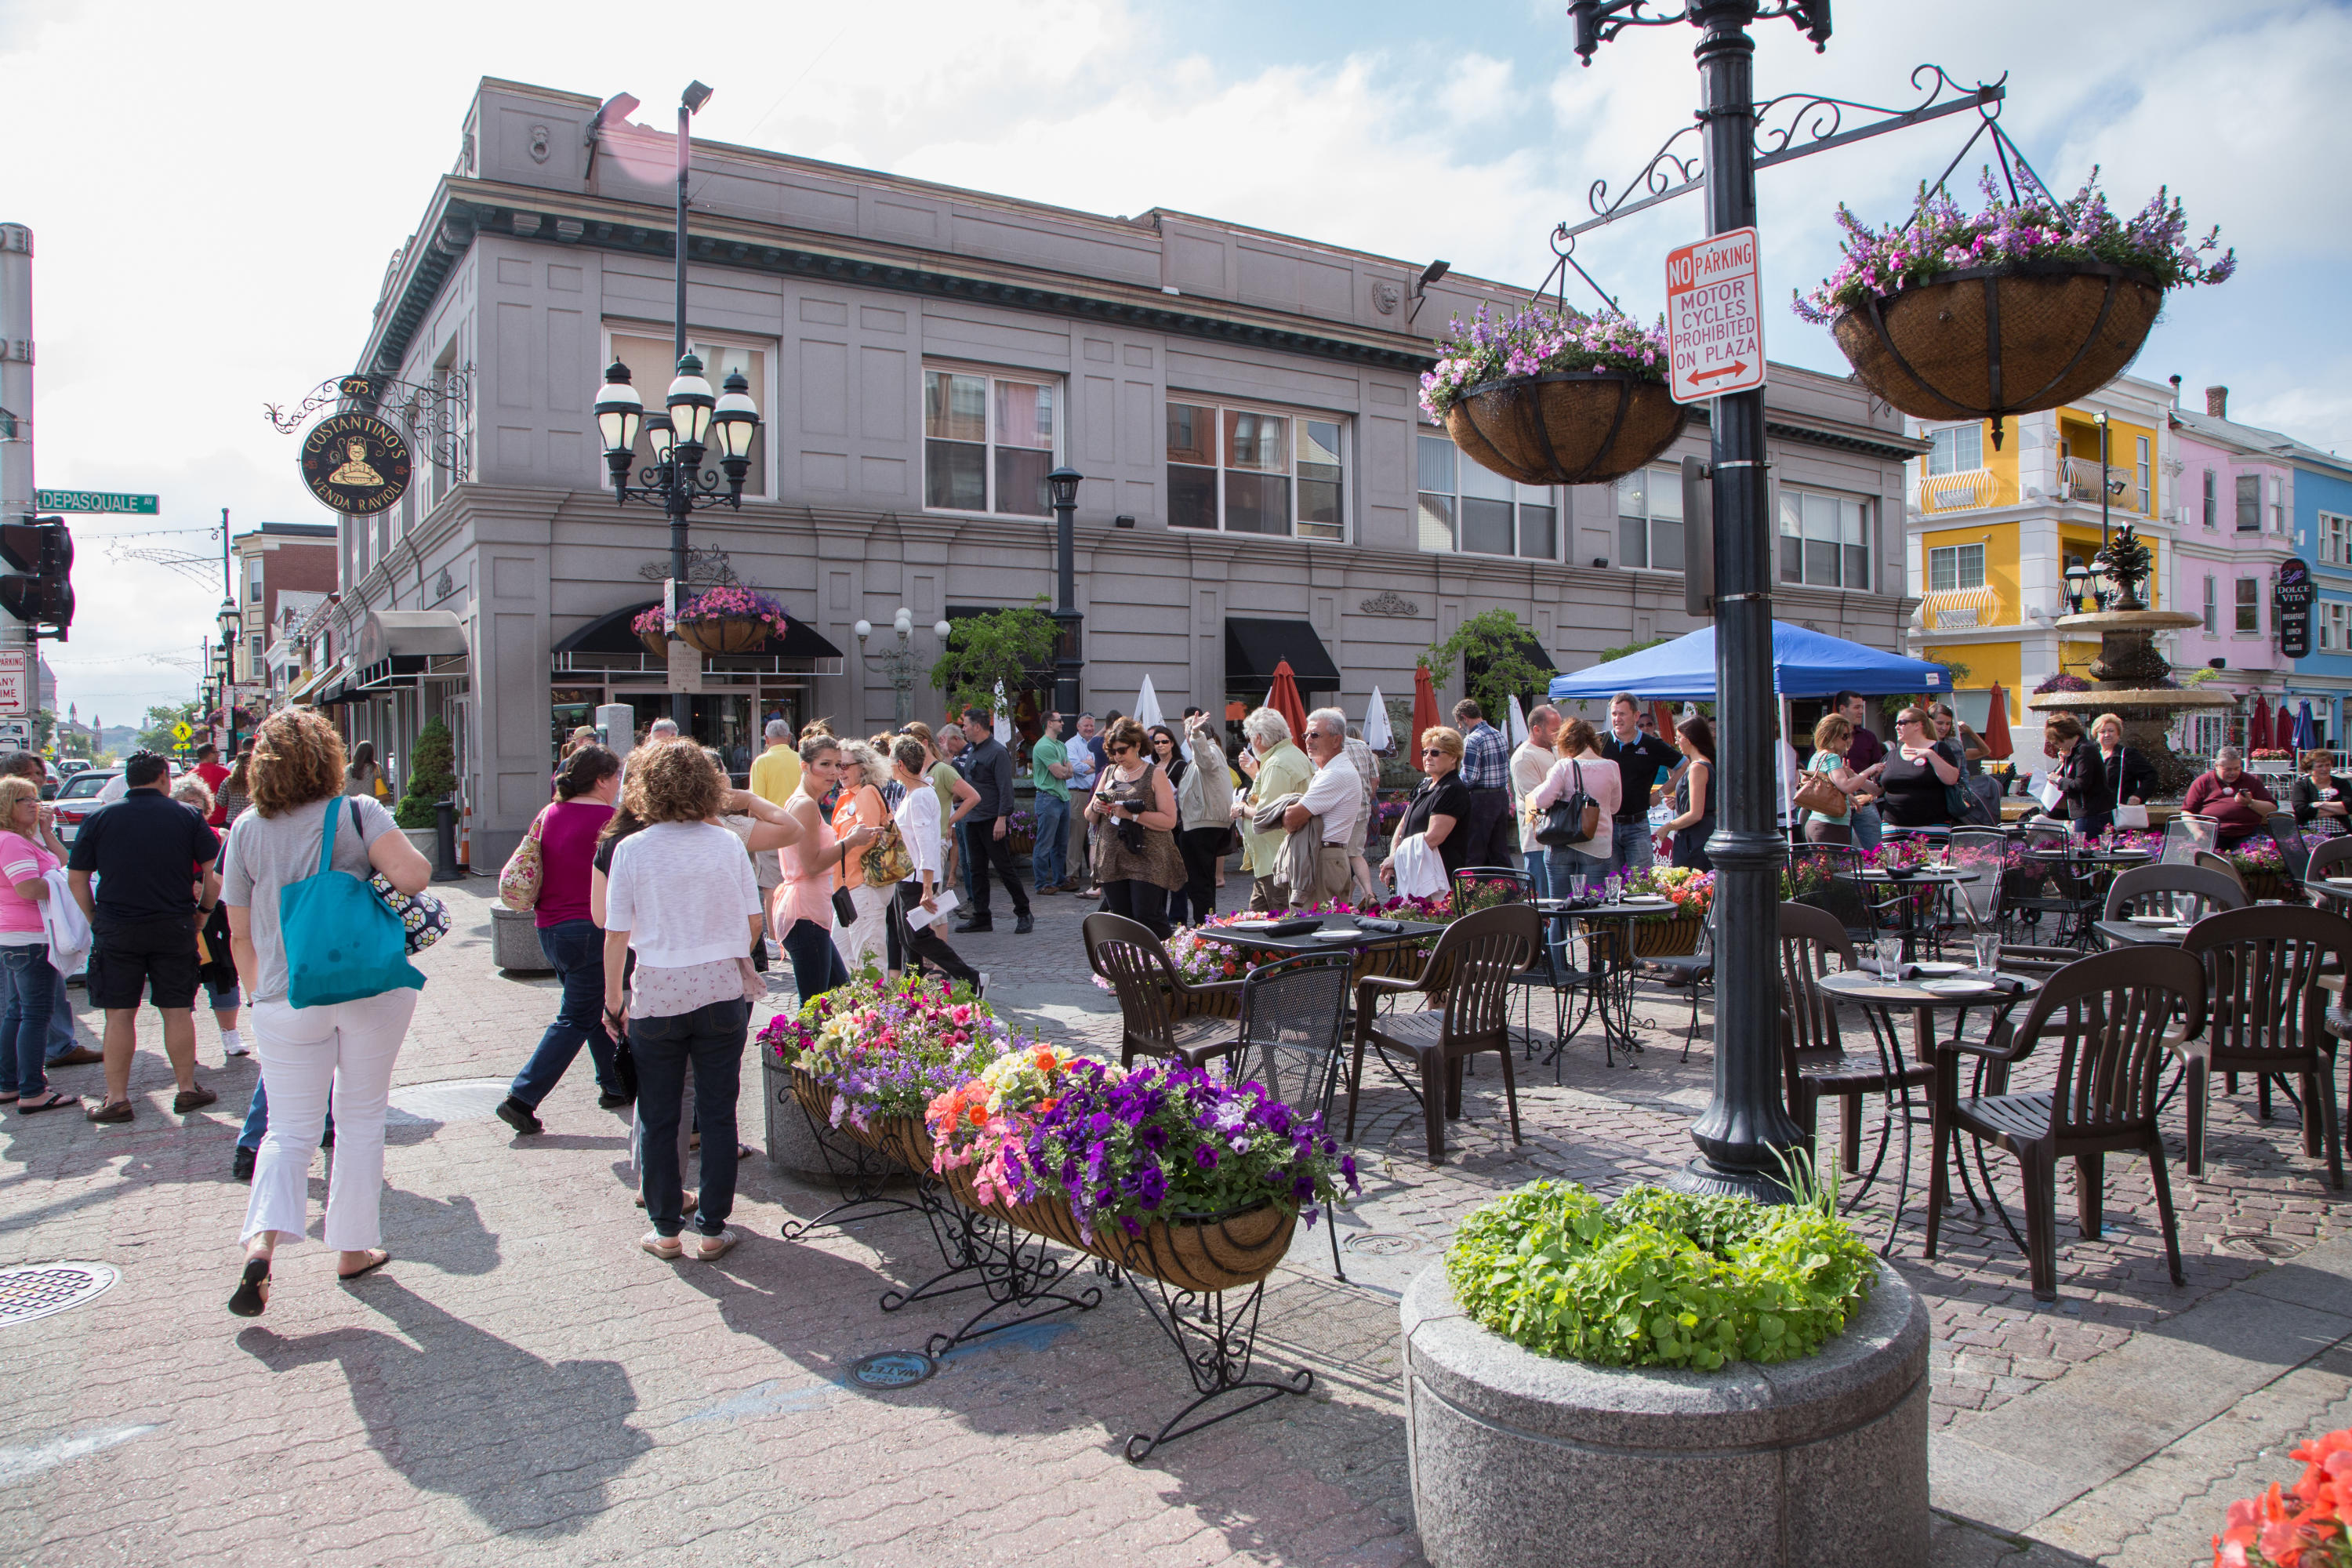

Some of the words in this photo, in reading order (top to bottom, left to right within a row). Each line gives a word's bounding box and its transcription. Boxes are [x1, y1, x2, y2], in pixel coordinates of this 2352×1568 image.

[1668, 256, 1693, 289] NO
[1695, 243, 1752, 278] PARKING
[1681, 280, 1746, 312] MOTOR
[1682, 299, 1747, 330] CYCLES
[1675, 317, 1755, 350] PROHIBITED
[1675, 350, 1696, 371] ON
[1705, 336, 1757, 364] PLAZA
[344, 380, 369, 394] 275
[307, 416, 407, 459] COSTANTINO'S
[42, 492, 139, 512] DEPASQUALE
[312, 476, 351, 510] VENDA
[358, 480, 404, 511] RAVIOLI
[2277, 585, 2310, 594] DOLCE
[2281, 593, 2306, 602] VITA
[2282, 612, 2306, 621] BREAKFAST
[0, 689, 16, 698] IME
[862, 1364, 919, 1377] WATER
